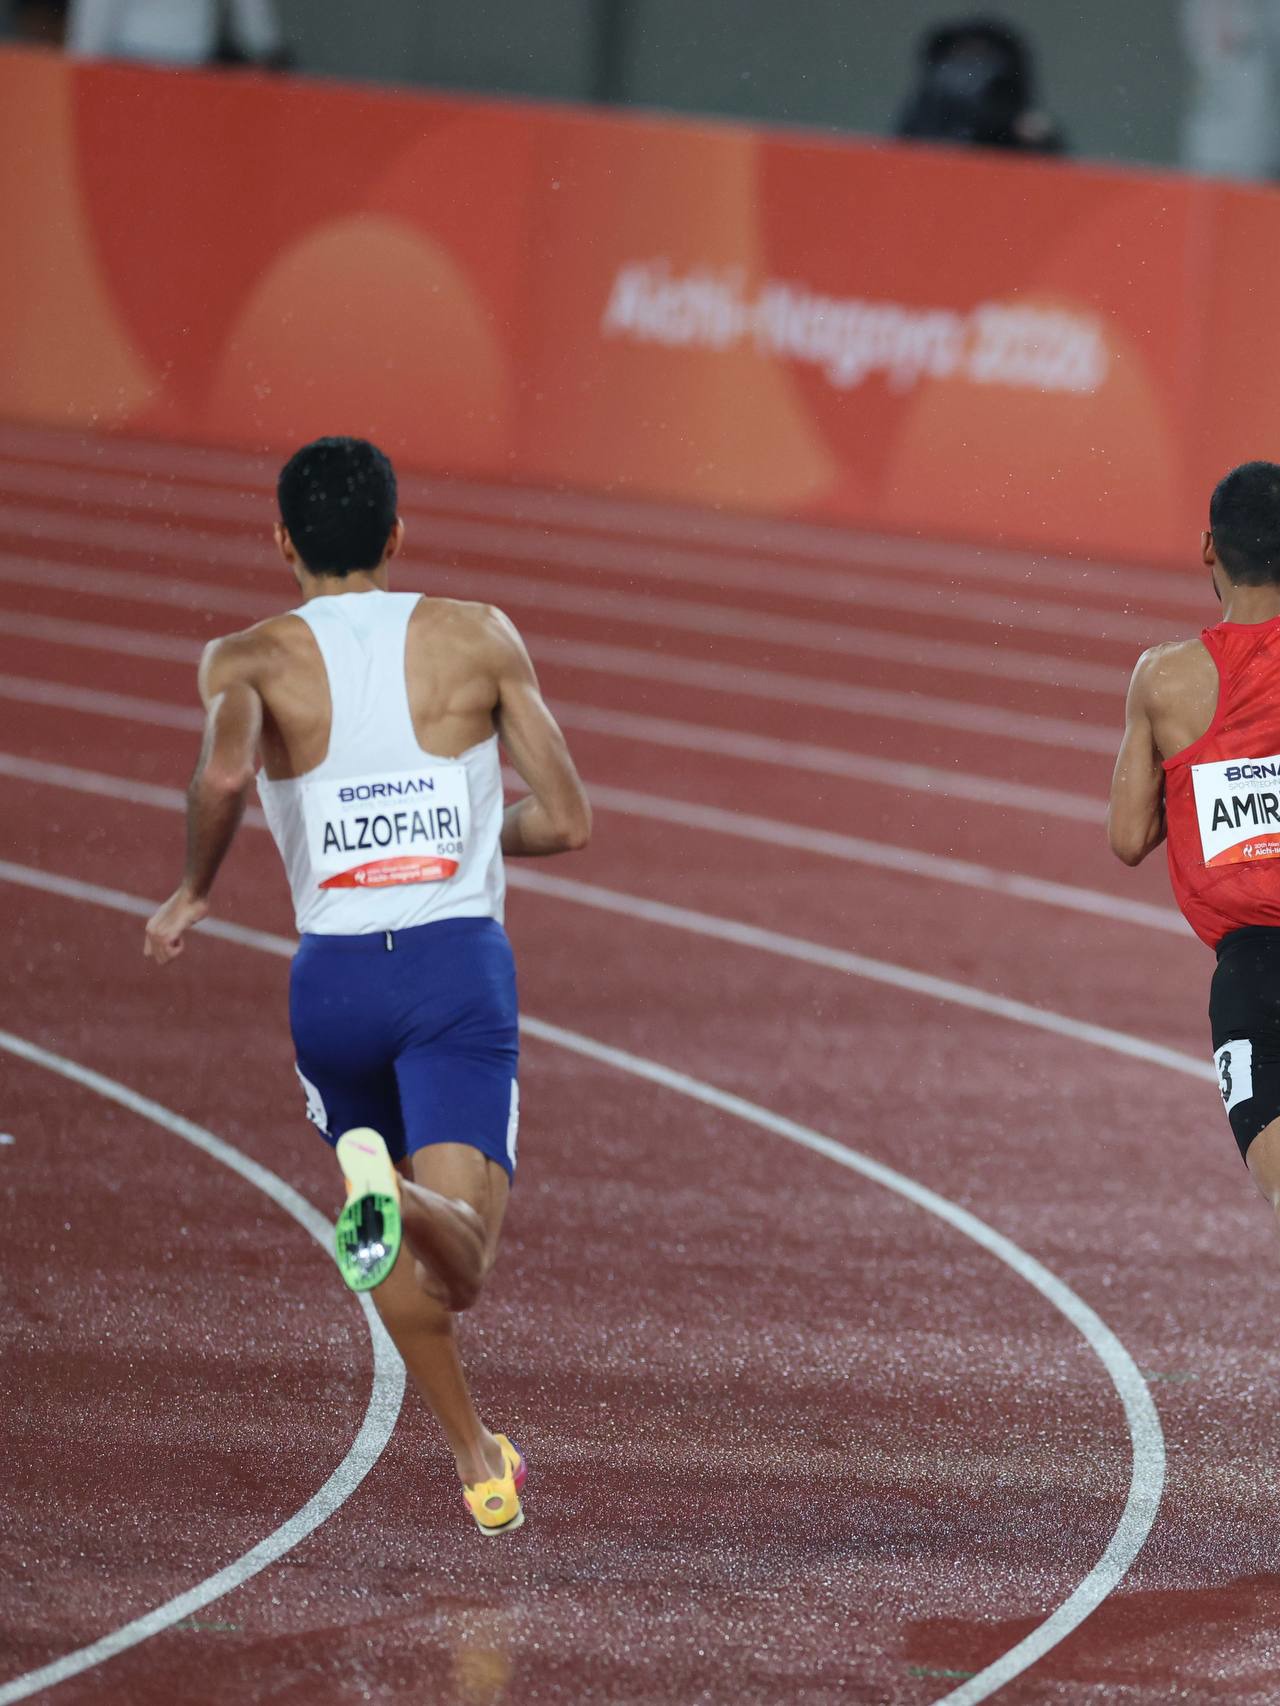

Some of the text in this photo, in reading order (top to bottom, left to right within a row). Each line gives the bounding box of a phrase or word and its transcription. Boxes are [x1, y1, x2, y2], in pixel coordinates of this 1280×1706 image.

[338, 778, 434, 802] BORNAN
[323, 805, 461, 854] ALZOFAIRI
[437, 842, 464, 855] 508
